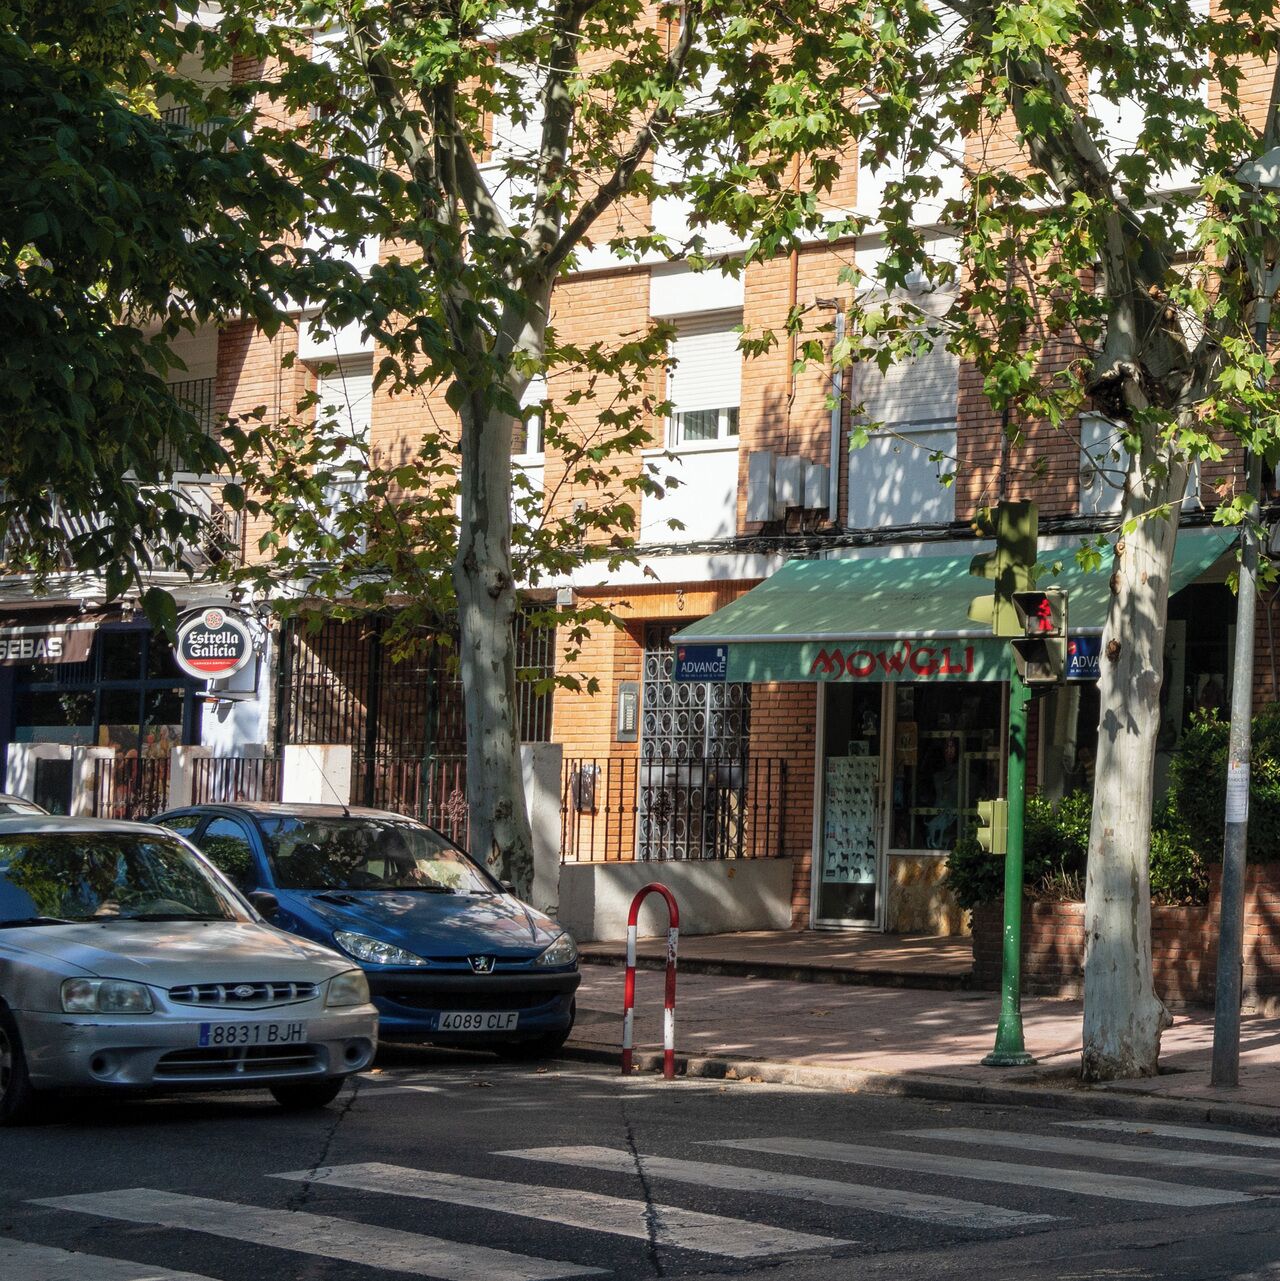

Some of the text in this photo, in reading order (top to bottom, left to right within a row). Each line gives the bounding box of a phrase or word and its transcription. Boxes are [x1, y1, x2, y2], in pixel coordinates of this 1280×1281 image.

[188, 631, 239, 645] Estrella
[190, 644, 236, 657] Galicia
[681, 662, 725, 673] ADVANCE
[809, 639, 974, 681] MOWGLI
[442, 1013, 515, 1030] 4089 CLF
[213, 1023, 302, 1044] 8831 BJH
